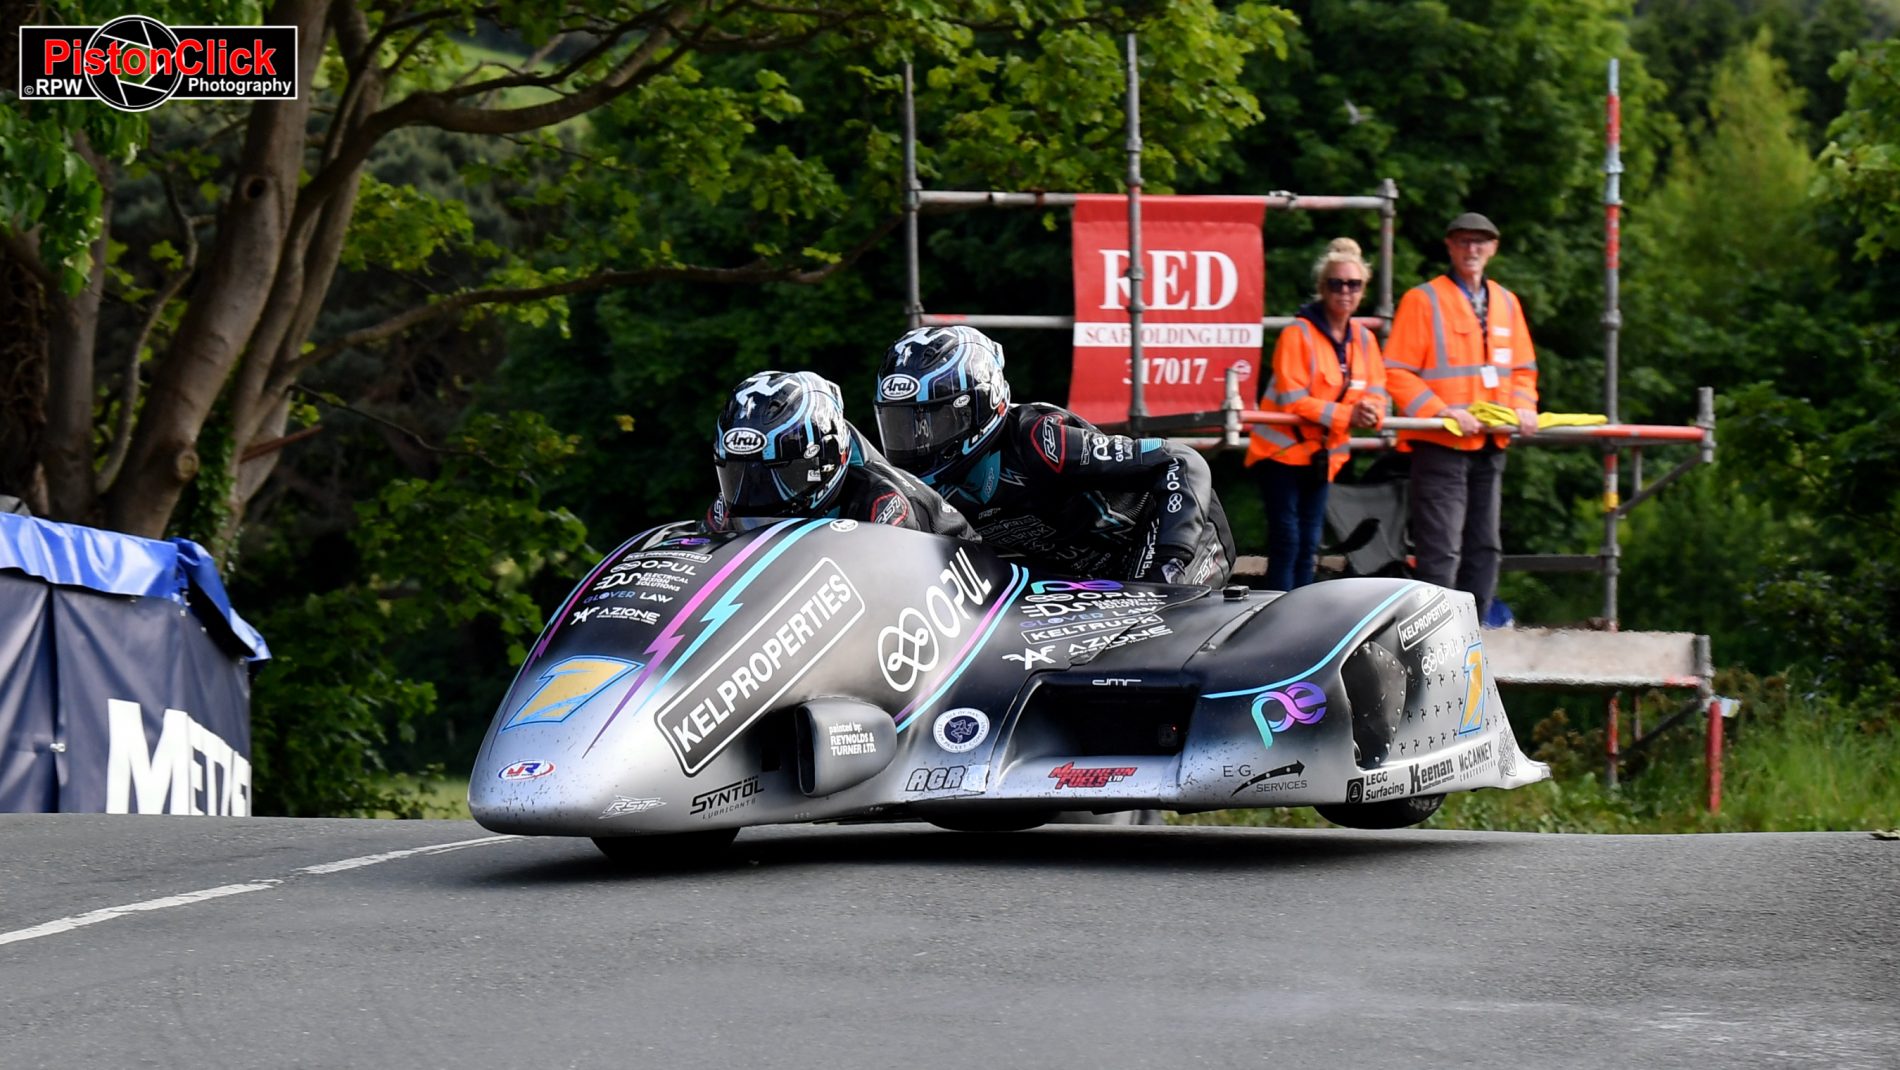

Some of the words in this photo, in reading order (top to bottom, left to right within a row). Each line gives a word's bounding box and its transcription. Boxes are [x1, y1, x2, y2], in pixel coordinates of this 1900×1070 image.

[1098, 249, 1239, 311] RED
[1085, 327, 1211, 345] SCAFOLDING
[1217, 328, 1250, 345] LTD
[882, 378, 913, 392] Arai
[726, 431, 759, 446] Arai
[640, 560, 697, 576] OPUL
[640, 591, 674, 604] LAW
[925, 546, 992, 638] OPUL
[1077, 591, 1168, 600] OPUL
[599, 606, 661, 621] AZIONE
[1401, 598, 1450, 643] KELPROPERTIES
[1030, 615, 1159, 641] KELTRUCK
[1067, 624, 1170, 653] AZIONE
[672, 574, 852, 753] KELPROPERTIES
[830, 733, 869, 746] REYNOLDS
[831, 743, 862, 756] TURNER
[1458, 740, 1493, 772] McCANNEY
[1055, 775, 1108, 790] FUELS
[1108, 775, 1125, 783] LTD
[1366, 771, 1388, 786] LEGG
[1409, 758, 1454, 795] Keenan
[1255, 779, 1308, 793] SERVICES
[1365, 782, 1405, 801] Surfacing
